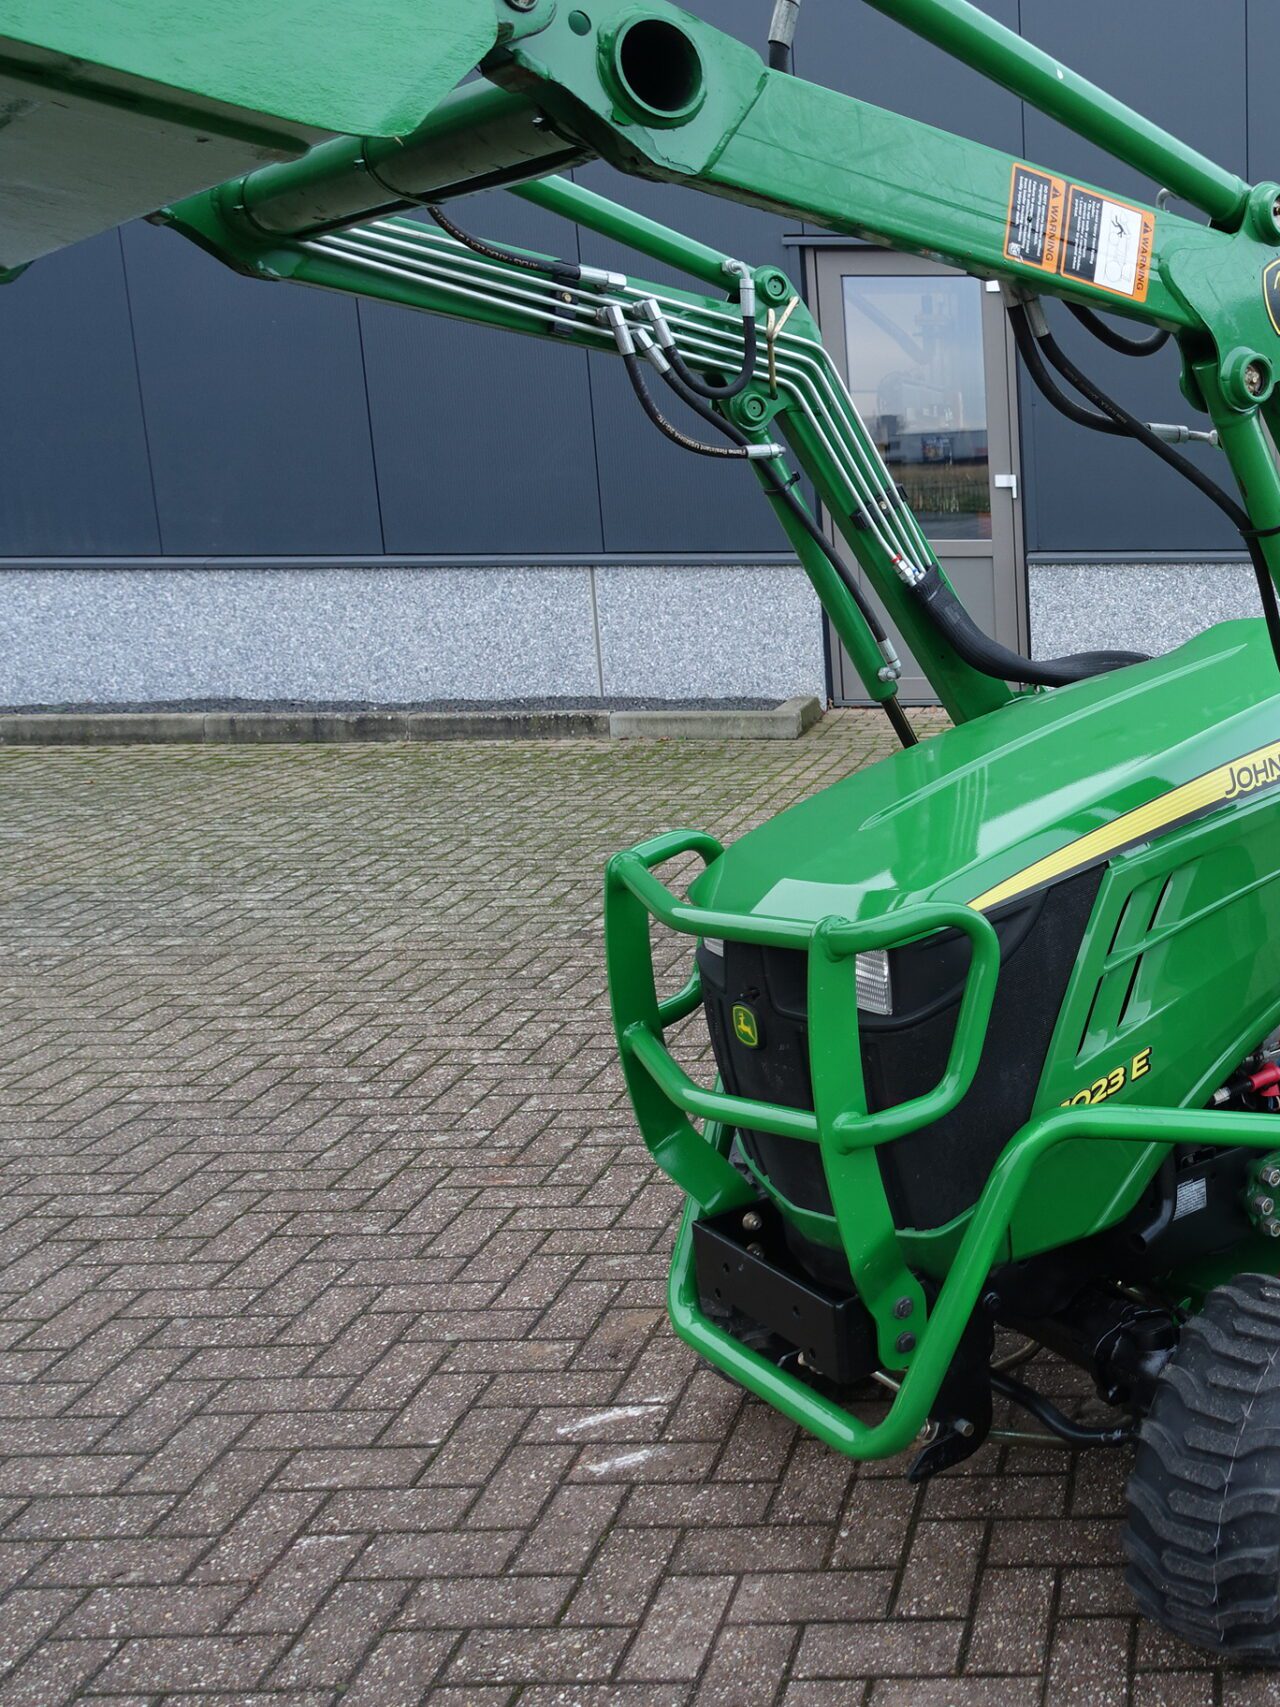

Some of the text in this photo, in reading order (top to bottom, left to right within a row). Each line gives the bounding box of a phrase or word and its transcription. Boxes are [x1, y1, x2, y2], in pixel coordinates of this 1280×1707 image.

[1046, 204, 1058, 262] WARNING
[1137, 236, 1149, 292] WARNING
[1131, 1047, 1153, 1081] E
